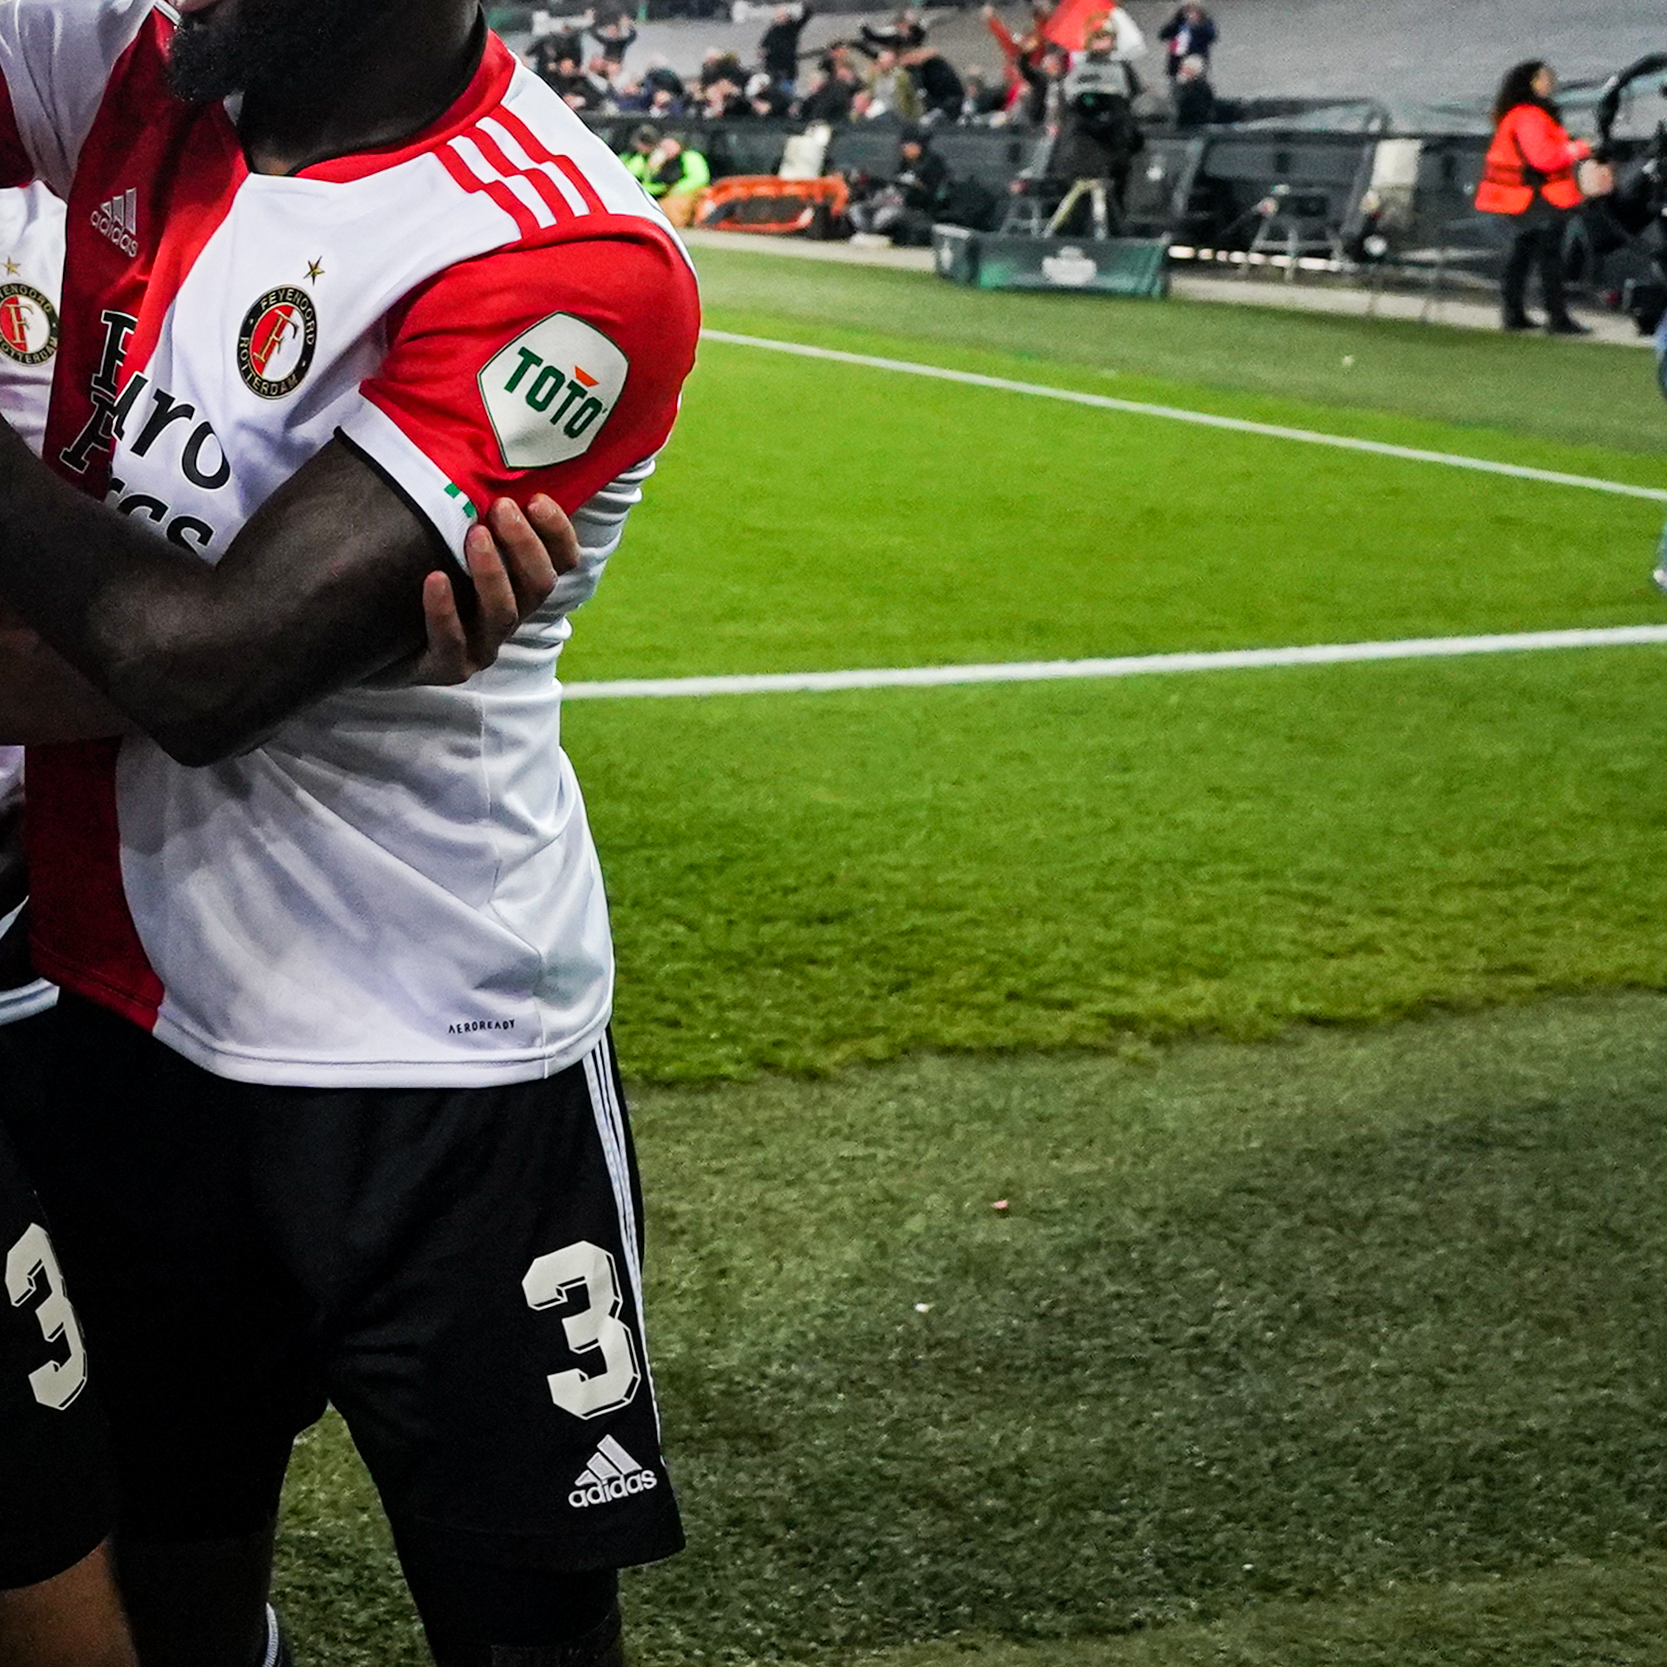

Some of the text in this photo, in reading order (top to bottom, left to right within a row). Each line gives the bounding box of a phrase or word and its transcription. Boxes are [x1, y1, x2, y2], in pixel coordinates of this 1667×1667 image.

[90, 210, 138, 257] adidas
[260, 288, 316, 345] FEYENOORD
[239, 336, 298, 395] ROTTERDAM
[504, 346, 605, 439] TOTO
[448, 1019, 515, 1034] AEROREADY
[5, 1222, 88, 1410] 3
[521, 1240, 641, 1420] 3
[568, 1470, 658, 1508] adidas
